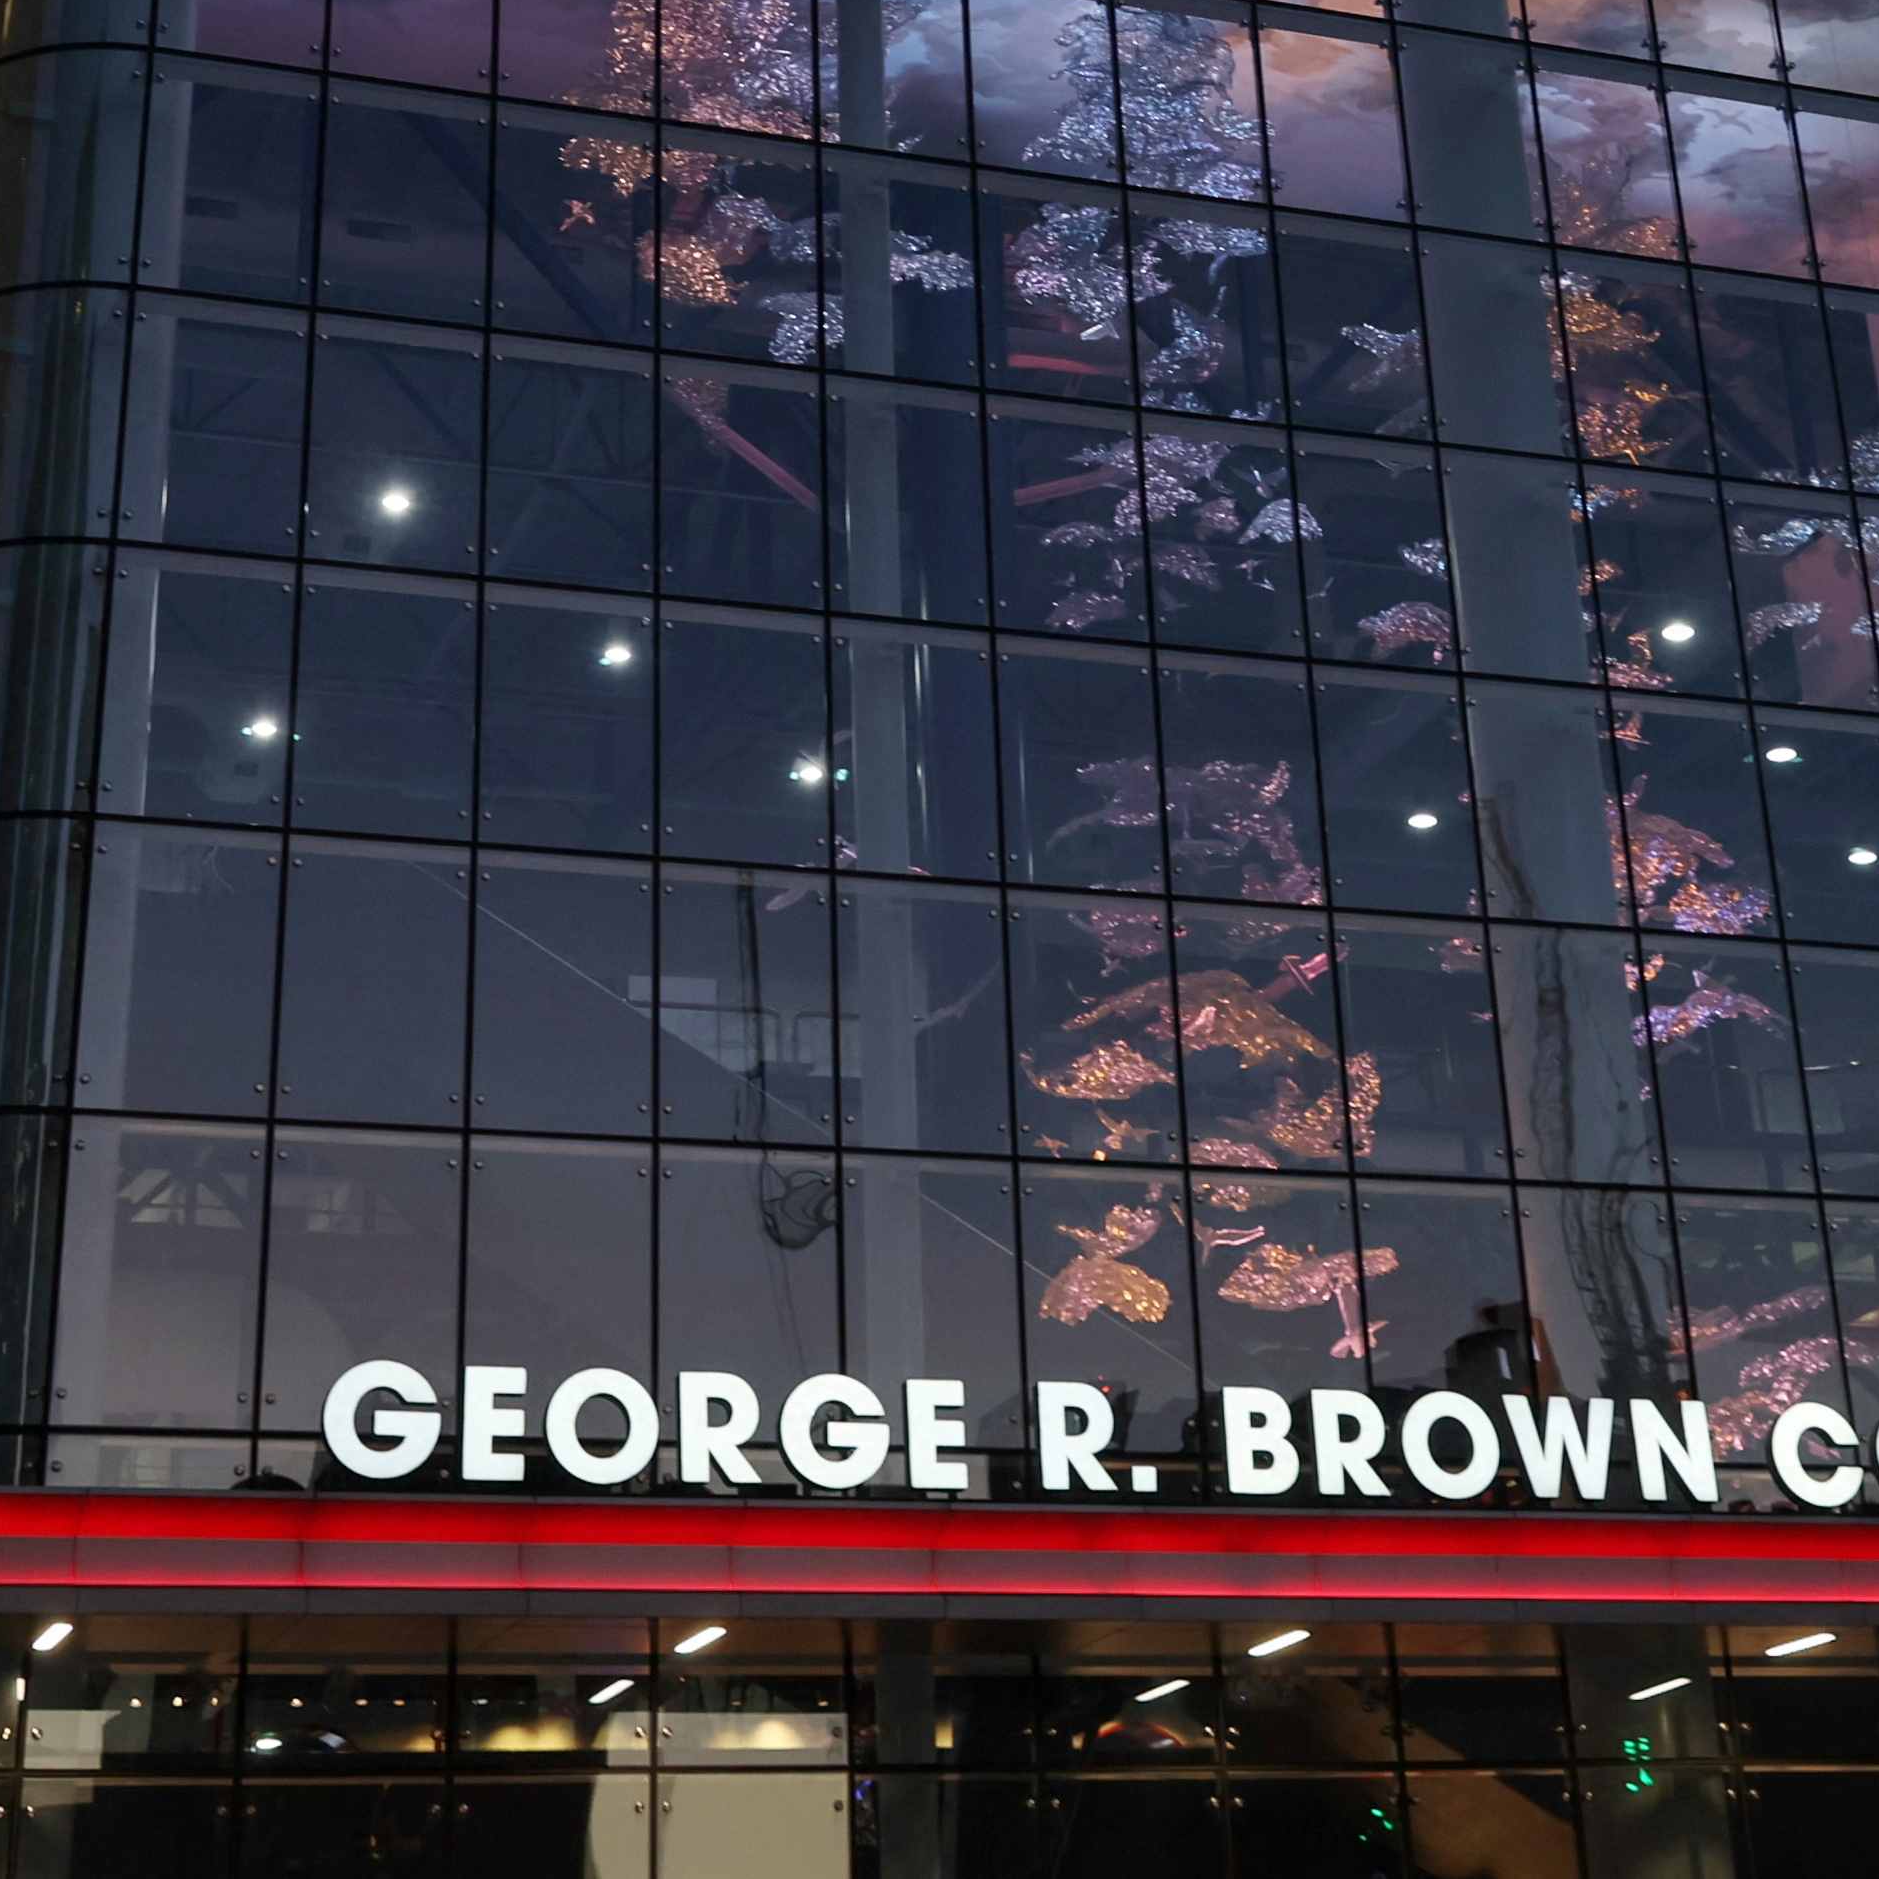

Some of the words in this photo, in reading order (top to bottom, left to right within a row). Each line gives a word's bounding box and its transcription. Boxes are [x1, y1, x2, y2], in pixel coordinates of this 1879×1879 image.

[322, 1358, 970, 1490] GEORGE
[1034, 1379, 1158, 1492] R.
[1220, 1385, 1720, 1502] BROWN
